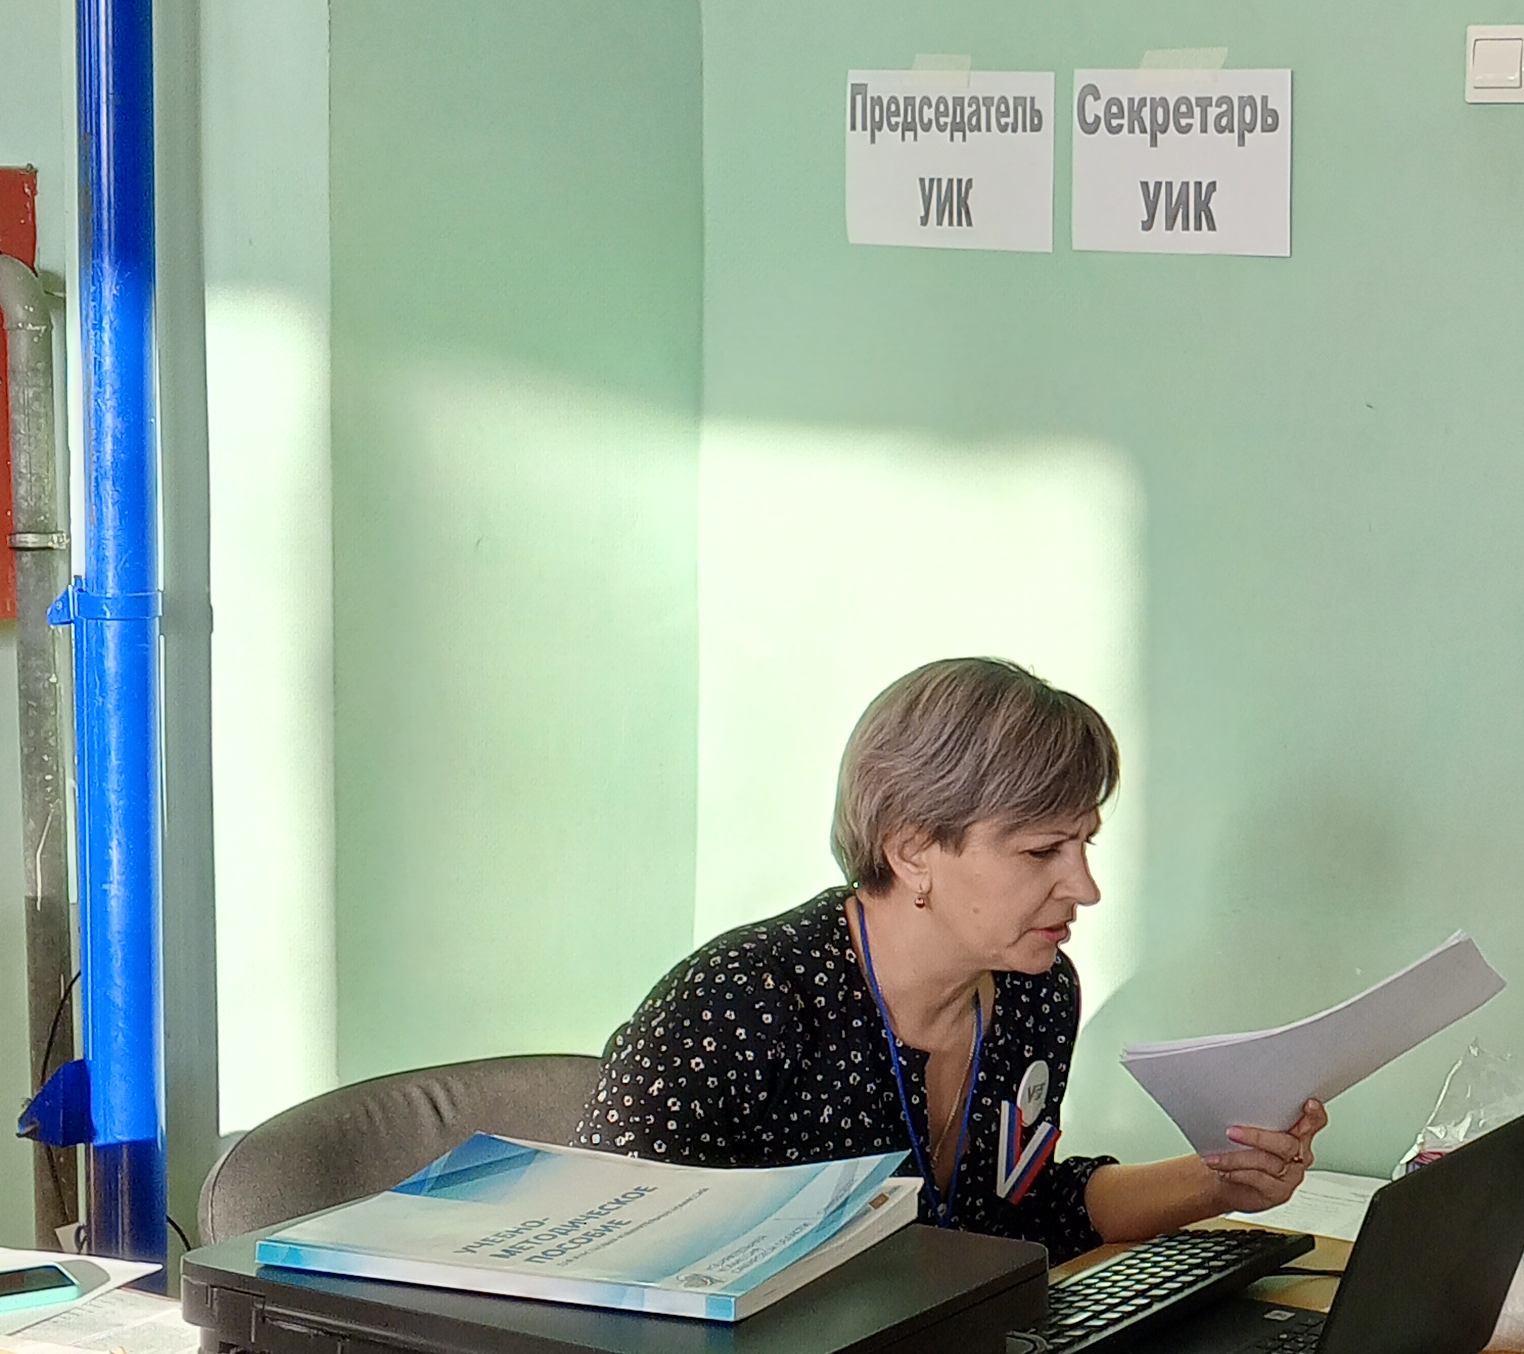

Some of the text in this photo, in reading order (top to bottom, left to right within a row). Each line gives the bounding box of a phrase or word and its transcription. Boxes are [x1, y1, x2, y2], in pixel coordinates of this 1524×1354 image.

[849, 82, 1044, 144] Председатель
[1076, 83, 1281, 148] Секретарь
[918, 177, 974, 227] УИК
[1139, 180, 1218, 232] УИК
[454, 1216, 550, 1256] УЧЕБНО-
[489, 1185, 659, 1260] МЕТОДИЧЕСКОЕ
[524, 1218, 632, 1265] ПОСОБИЕ
